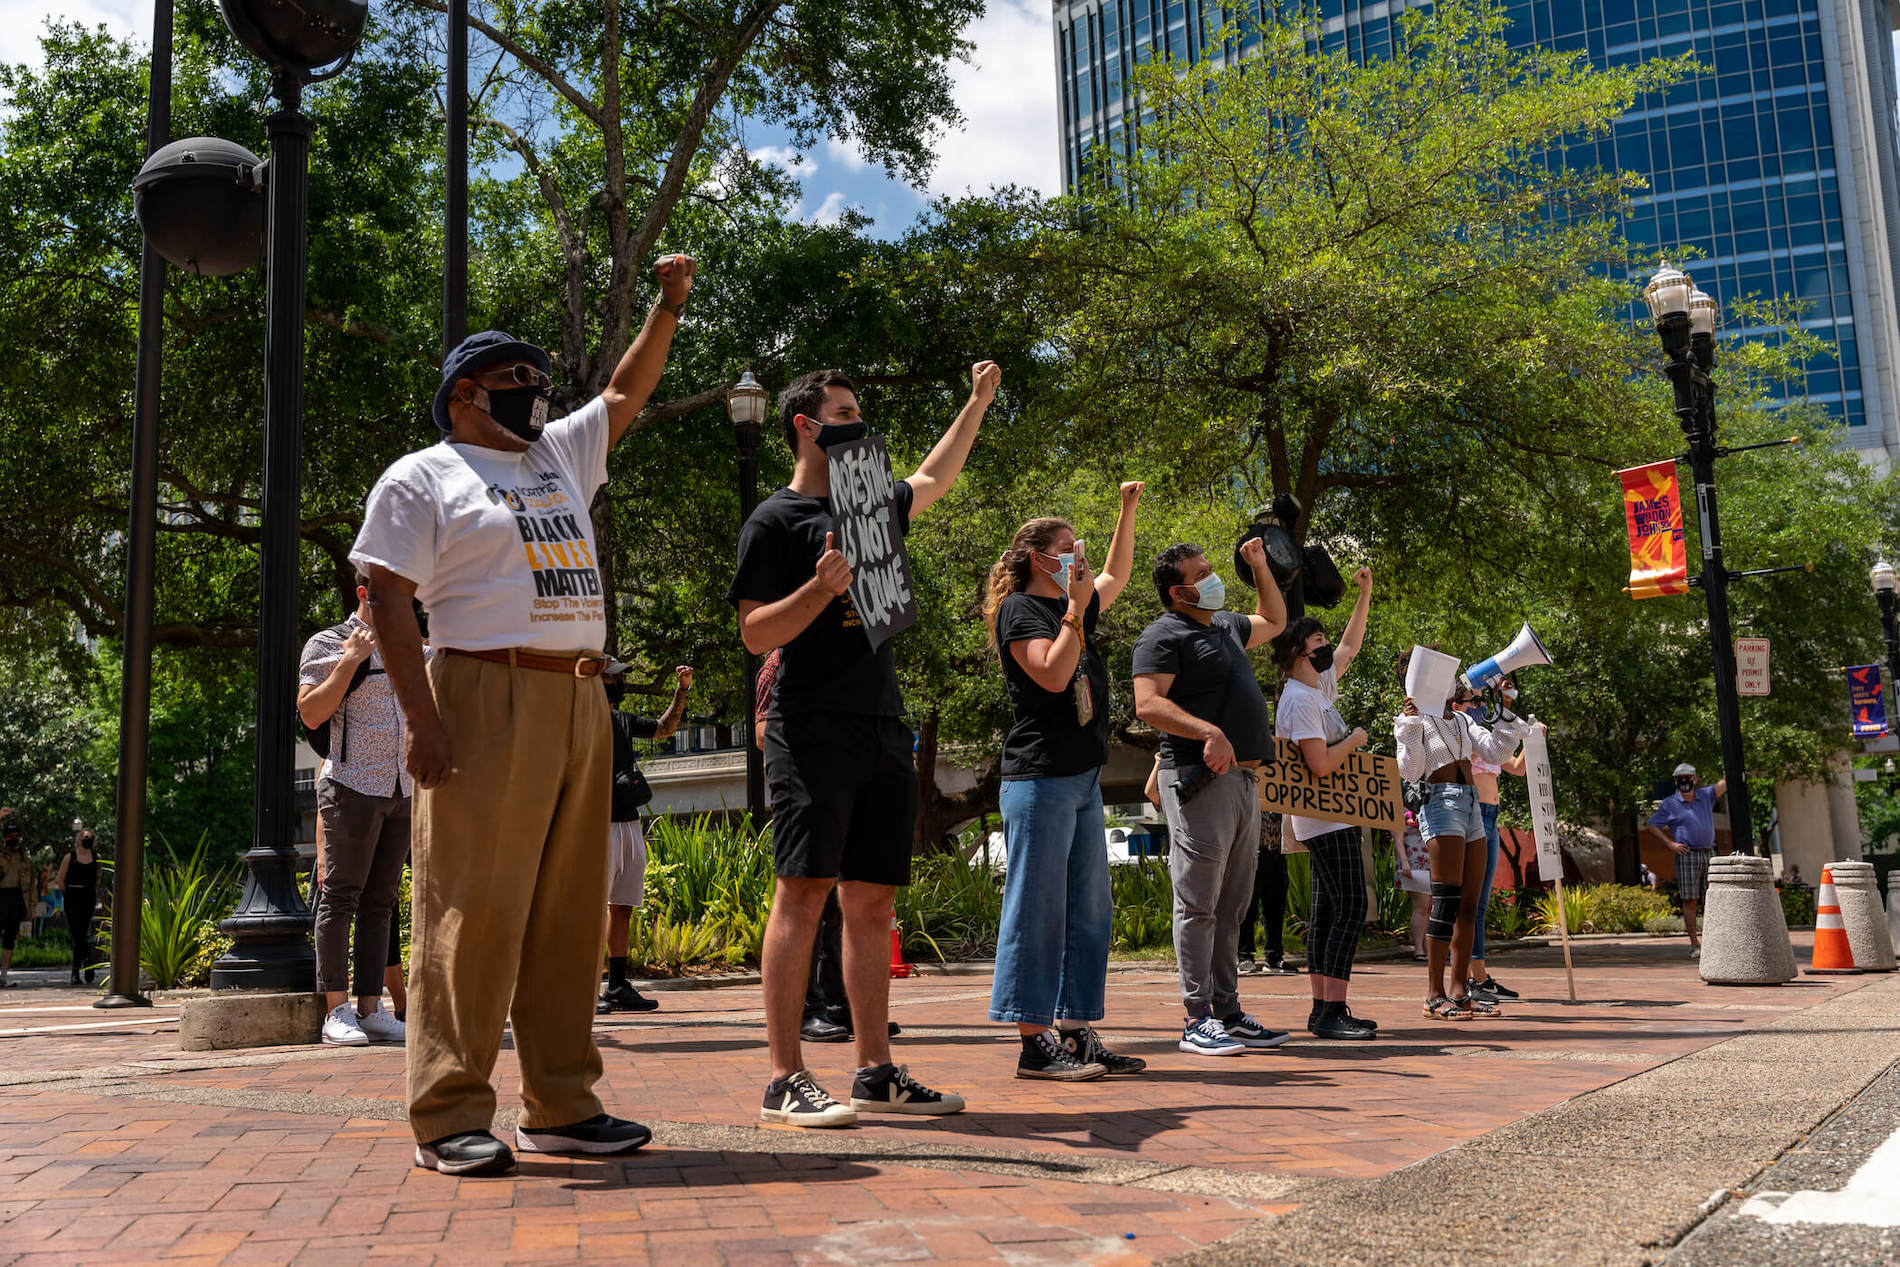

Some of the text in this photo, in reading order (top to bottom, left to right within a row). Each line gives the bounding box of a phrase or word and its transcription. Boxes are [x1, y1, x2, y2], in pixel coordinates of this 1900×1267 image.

[829, 444, 894, 518] PROTESTING
[1634, 495, 1670, 513] JAMES
[515, 514, 585, 543] BLACK
[840, 506, 893, 568] IS NOT
[524, 540, 594, 571] LIVES
[857, 553, 911, 627] CRIME
[534, 598, 560, 610] Stop
[562, 597, 580, 608] The
[529, 611, 575, 623] Increase
[1742, 668, 1763, 677] PERMIT
[1744, 681, 1761, 689] ONLY
[1366, 777, 1391, 797] OF
[1265, 782, 1396, 821] OPPRESSION
